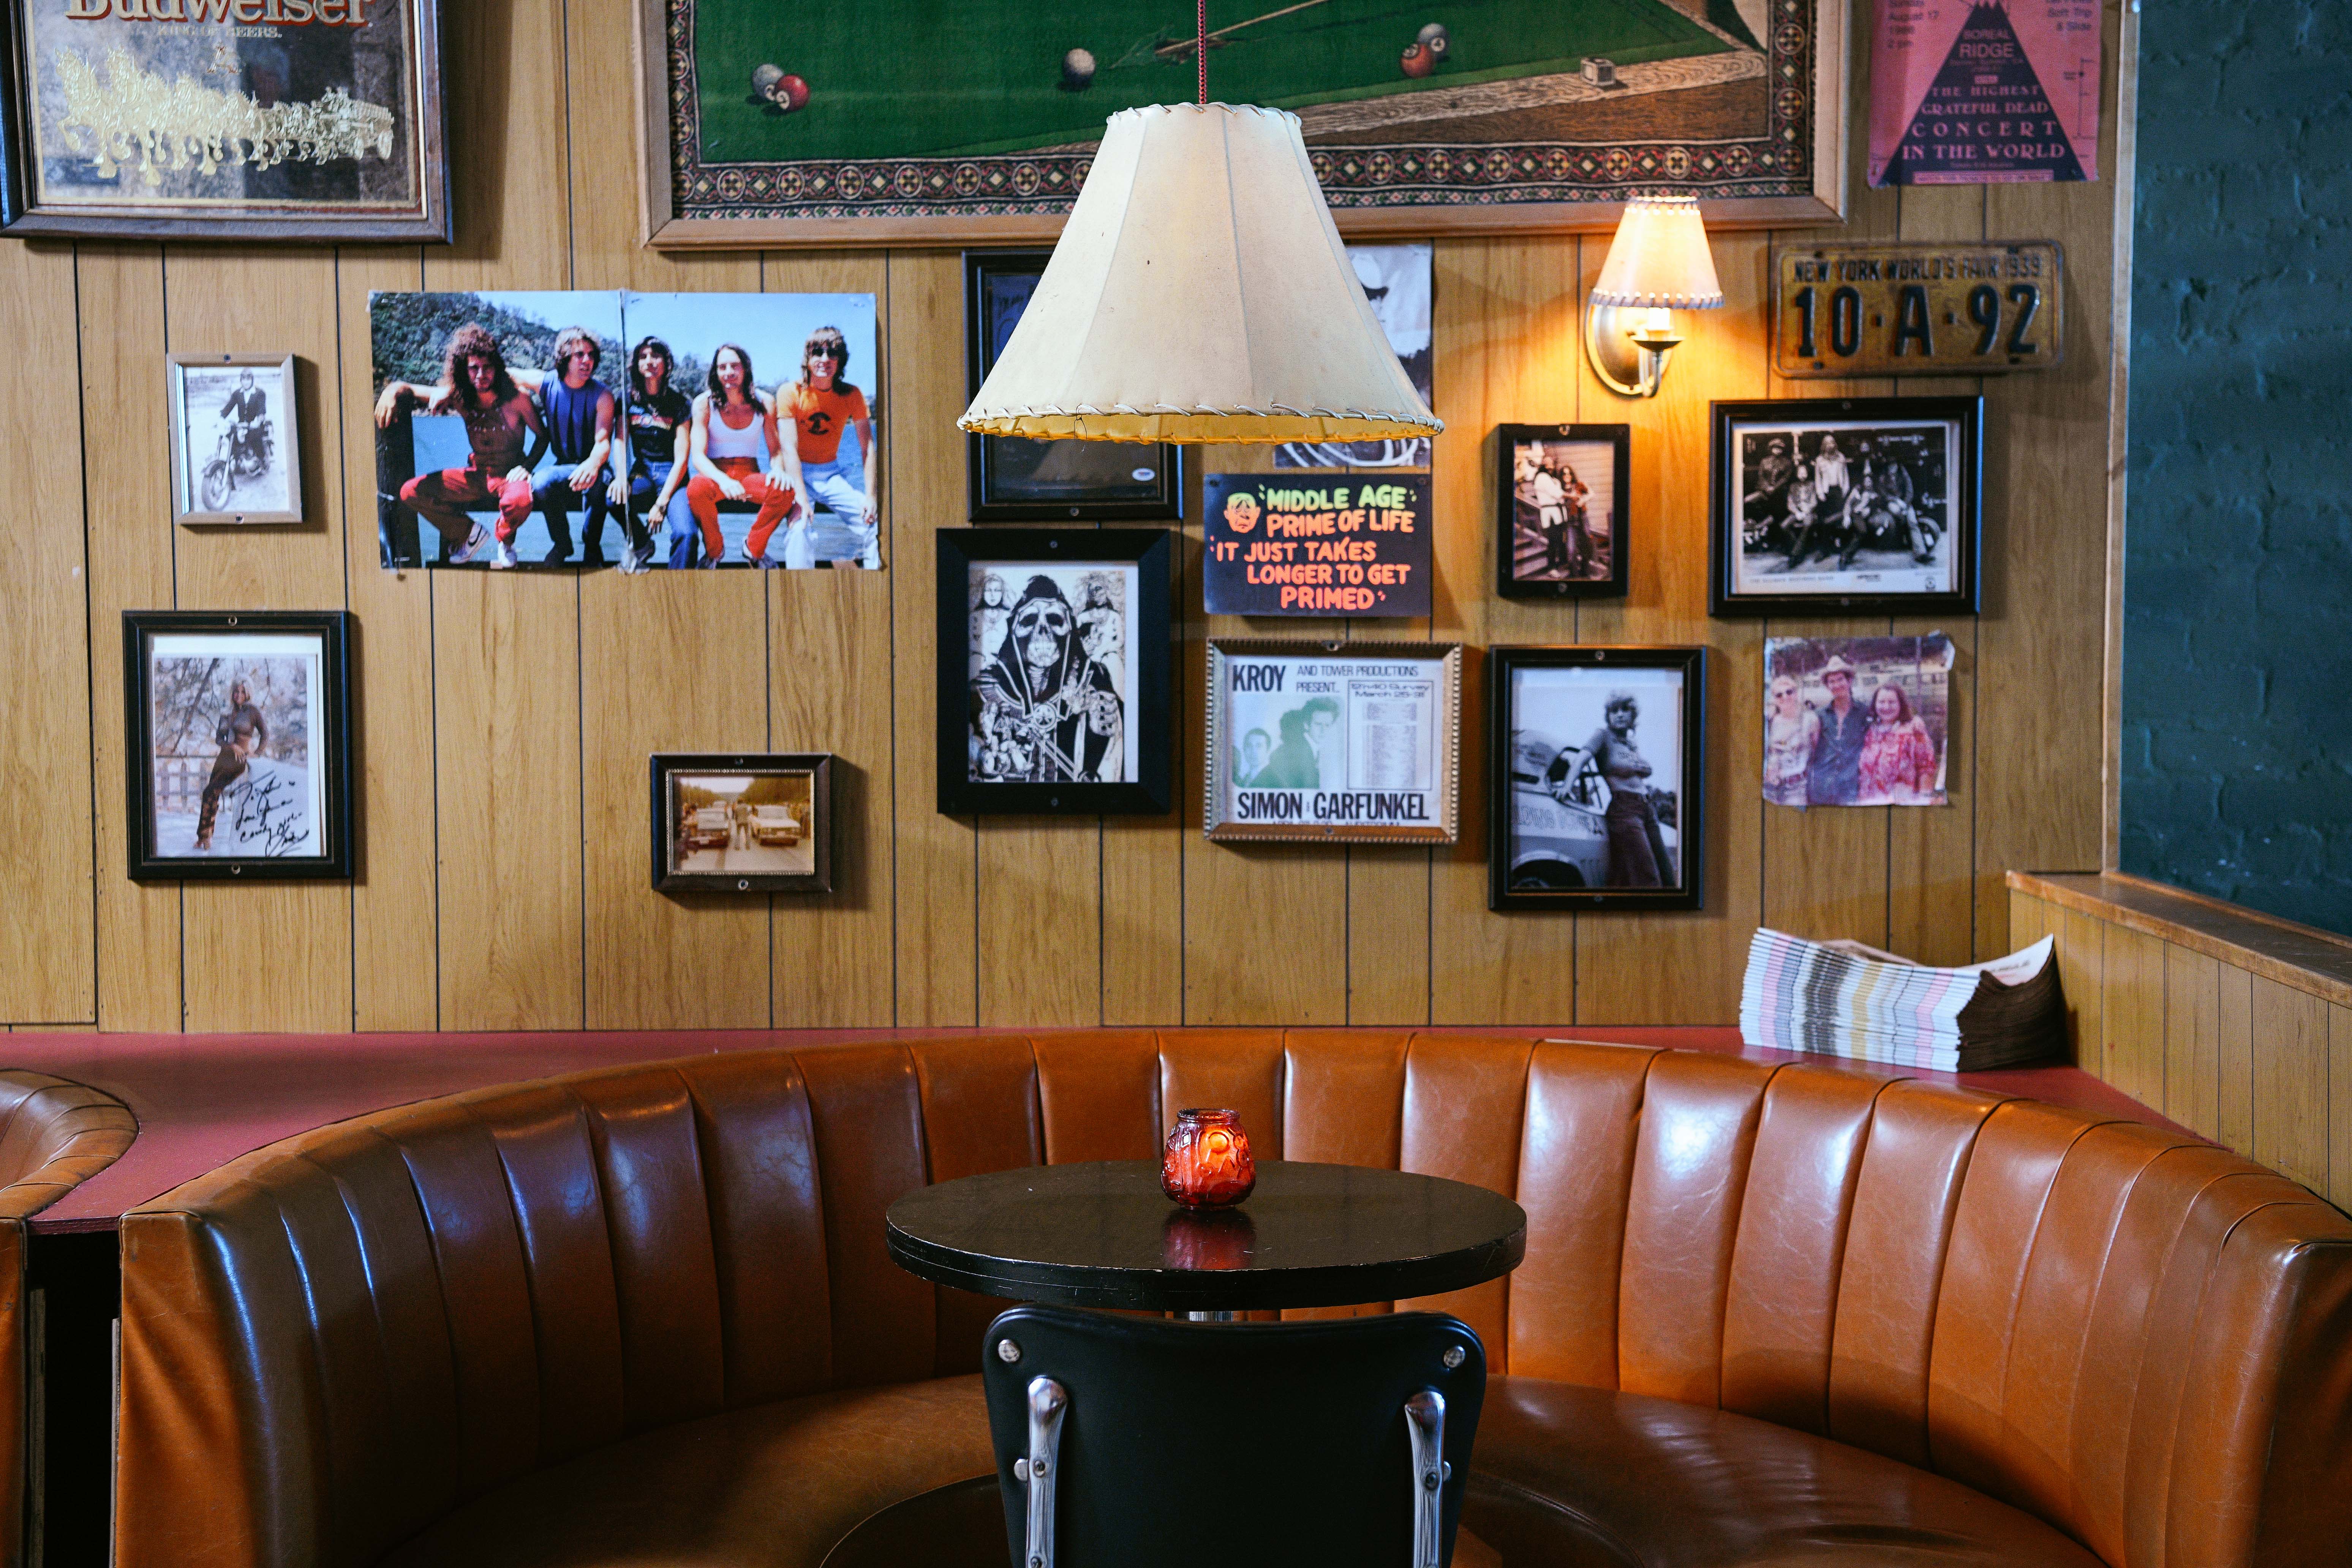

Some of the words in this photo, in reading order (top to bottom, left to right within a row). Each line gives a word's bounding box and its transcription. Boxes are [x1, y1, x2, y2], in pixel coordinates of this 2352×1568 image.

[157, 25, 196, 36] KING
[200, 26, 218, 36] OF
[1959, 43, 2014, 58] RIDGE
[1931, 86, 1962, 96] THE
[1970, 85, 2040, 96] HIGHEST
[1921, 102, 2000, 116] GRATEFUL
[2004, 102, 2049, 114] DEAD
[1912, 121, 2058, 138] CONCERT
[1902, 145, 1924, 160] IN
[1933, 144, 1978, 158] THE
[1985, 144, 2065, 160] WORLD
[1794, 260, 1830, 281] NEW
[1836, 259, 1881, 281] YORK
[1961, 256, 2000, 279] FAIR
[2005, 254, 2042, 278] 1939
[1266, 512, 1337, 537] PRIME
[1338, 509, 1366, 533] OF
[1369, 509, 1416, 533] LIFE
[1244, 541, 1298, 562] JUST
[1305, 536, 1377, 562] TAKES
[1247, 564, 1333, 585] LONGER
[1337, 565, 1364, 584] TO
[1367, 564, 1411, 585] GET
[1232, 664, 1287, 692] KROY
[1297, 665, 1317, 676] AND
[1321, 665, 1354, 676] TOWER
[1356, 665, 1419, 677] PRODUCTIONS
[1238, 792, 1302, 819] SIMON
[1314, 792, 1429, 820] GARFUNKEL
